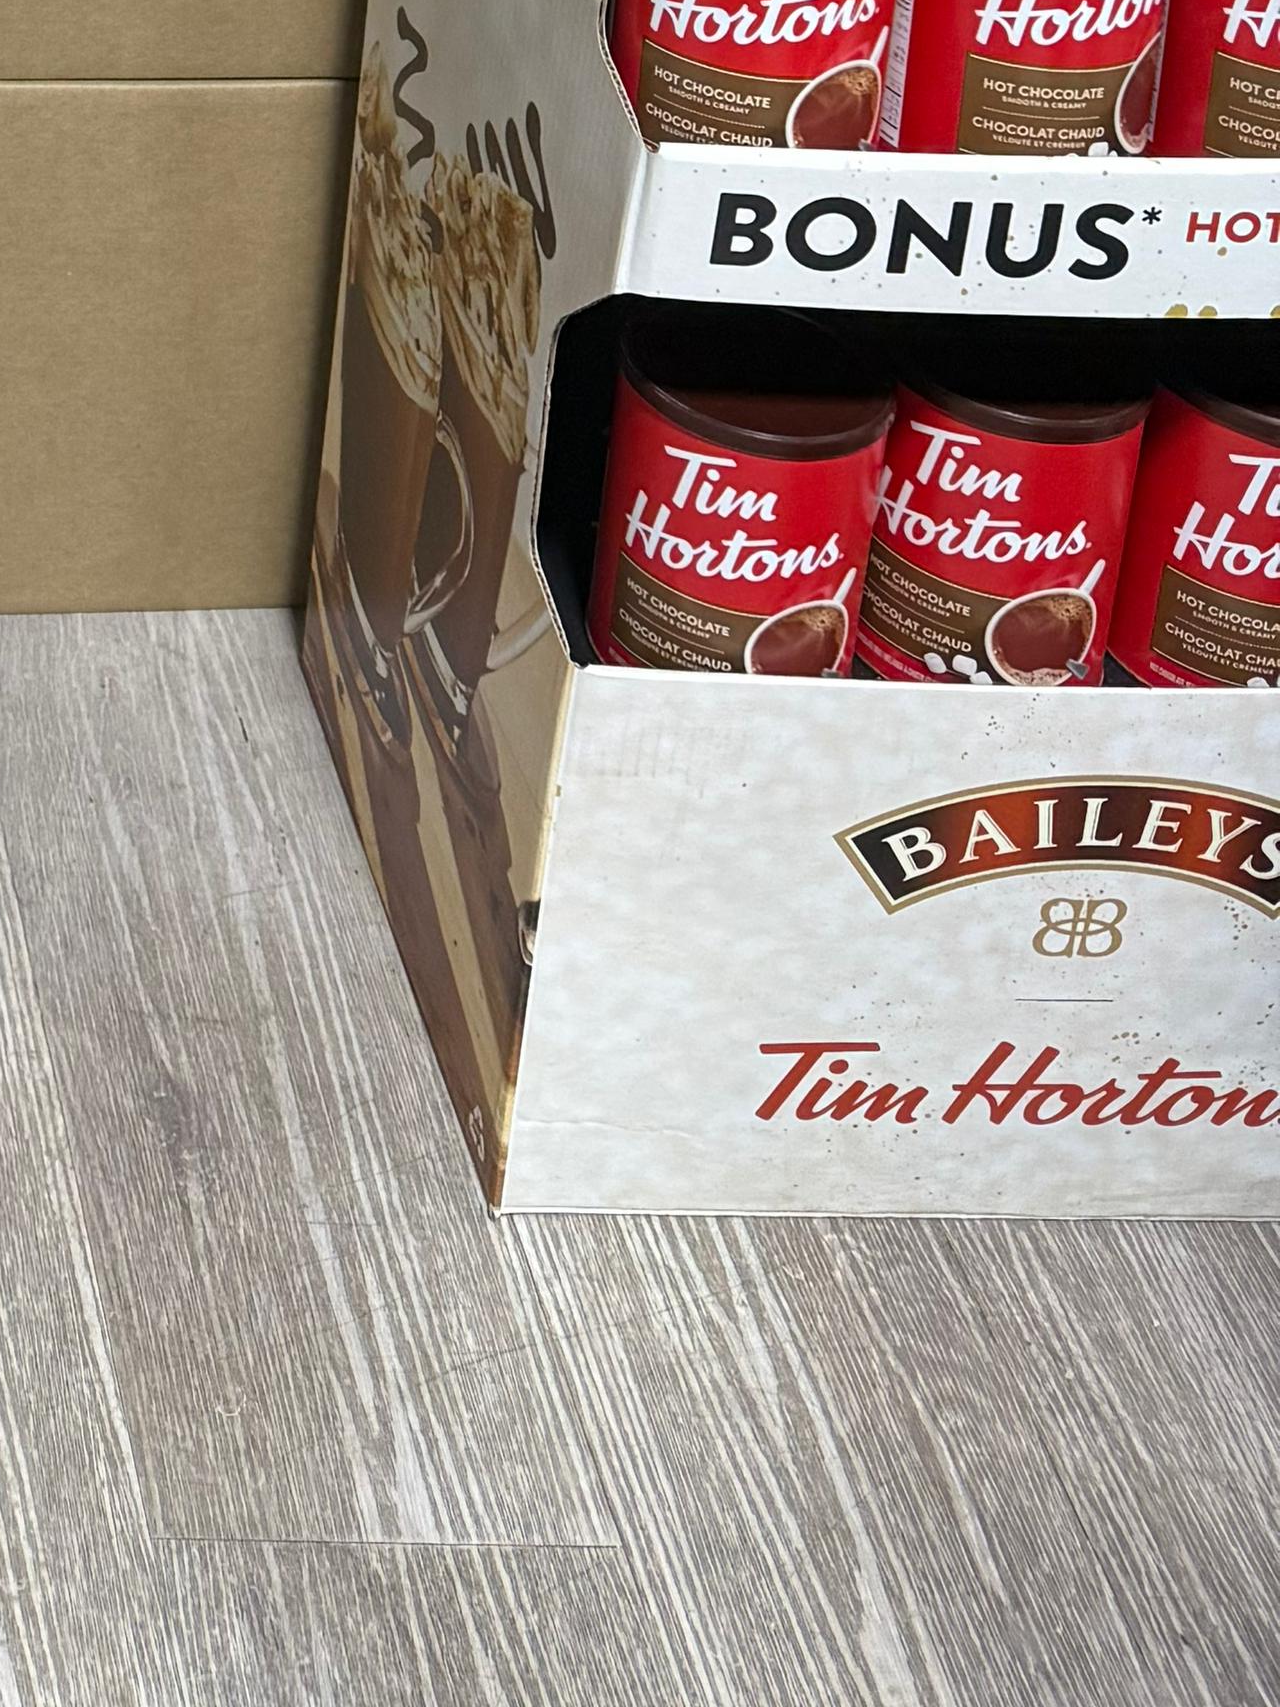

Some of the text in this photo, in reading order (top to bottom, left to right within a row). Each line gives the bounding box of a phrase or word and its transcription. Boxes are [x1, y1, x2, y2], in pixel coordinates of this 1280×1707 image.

[653, 65, 681, 86] HOT
[682, 78, 772, 109] CHOCOLATE
[983, 77, 1105, 100] HOT CHOCOLATE
[1229, 76, 1263, 95] HOT
[645, 102, 718, 139] CHOCOLAT
[720, 130, 773, 148] CHAUD
[972, 116, 1105, 140] CHOCOLAT CHAUD
[1186, 211, 1280, 243] HOT
[663, 444, 779, 522] Tim
[910, 420, 1023, 503] Tim
[624, 489, 836, 583] Hortons
[876, 465, 1086, 563] Hortons
[627, 577, 649, 600] HOT
[650, 595, 731, 638] CHOCOLATE
[892, 571, 971, 617] CHOCOLATE
[1177, 590, 1206, 612] HOT
[620, 607, 681, 655] CHOCOLAT
[682, 650, 733, 672] CHAUD
[922, 627, 972, 653] CHAUD
[1164, 622, 1244, 661] CHOCOLAT
[881, 795, 1280, 883] BAILEYS
[754, 1040, 935, 1125] Tim
